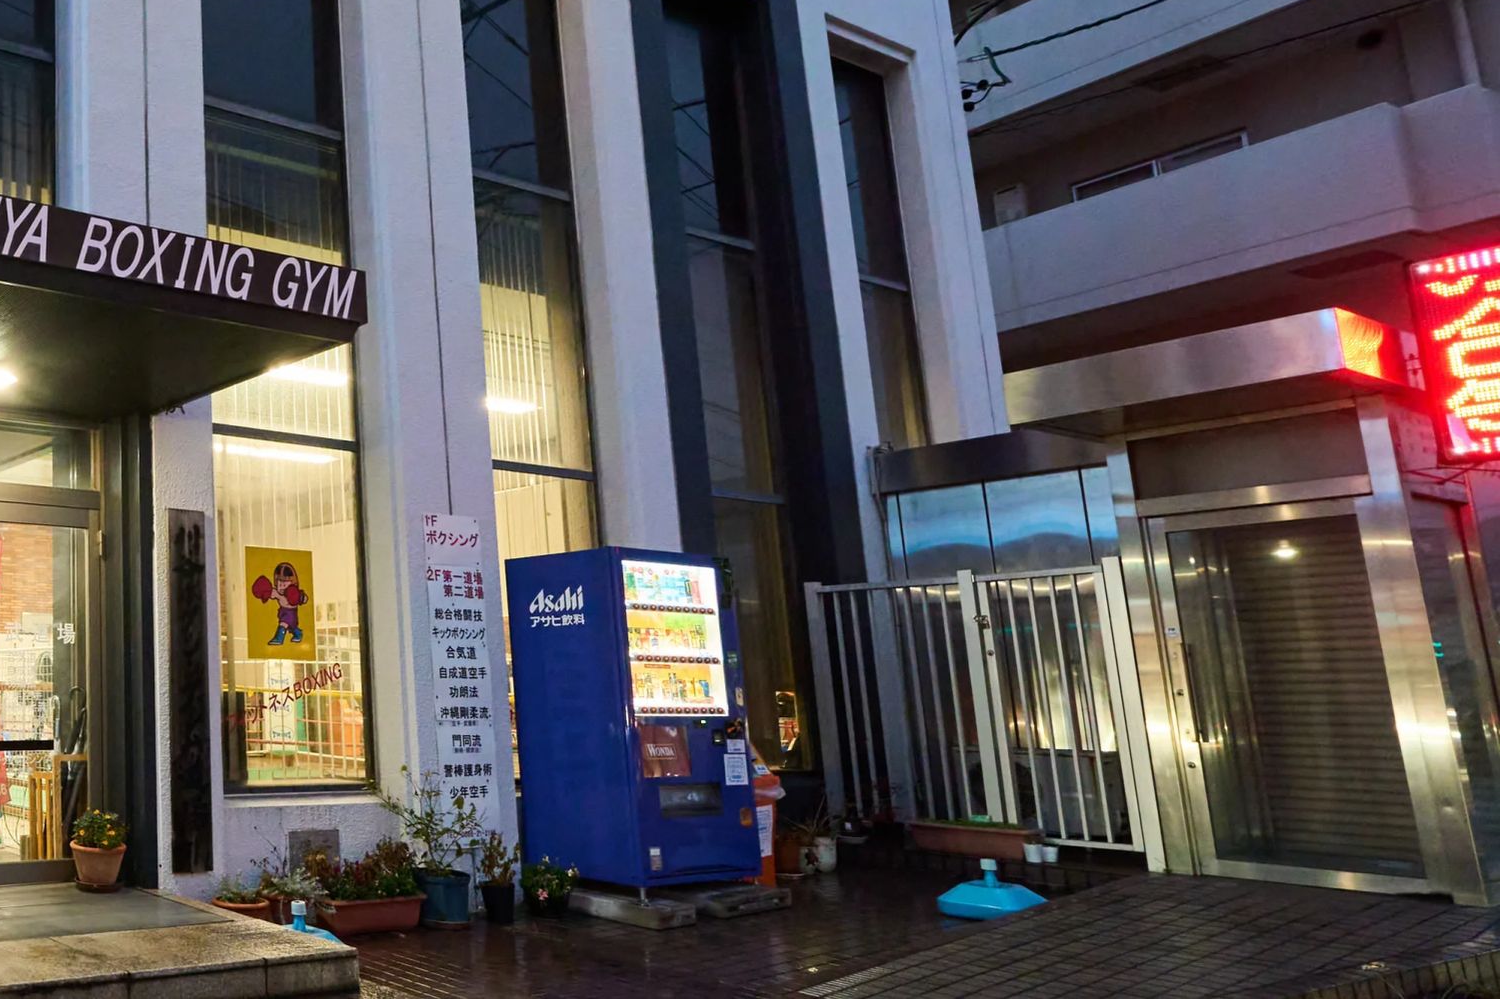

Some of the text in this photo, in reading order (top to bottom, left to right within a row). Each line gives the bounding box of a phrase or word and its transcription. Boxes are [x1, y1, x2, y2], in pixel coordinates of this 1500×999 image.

[76, 217, 254, 300] BOXING
[272, 257, 358, 319] GYM
[426, 530, 479, 548] ボクシング
[443, 584, 484, 600] 第二道場
[529, 584, 584, 614] Asahi
[434, 607, 483, 622] 総合格闘技
[529, 613, 585, 628] アサヒ飲料
[432, 626, 486, 640] キックボクシング
[445, 645, 477, 660] 合気道
[440, 706, 489, 720] 沖縄剛柔流
[449, 785, 489, 800] 少年空手
